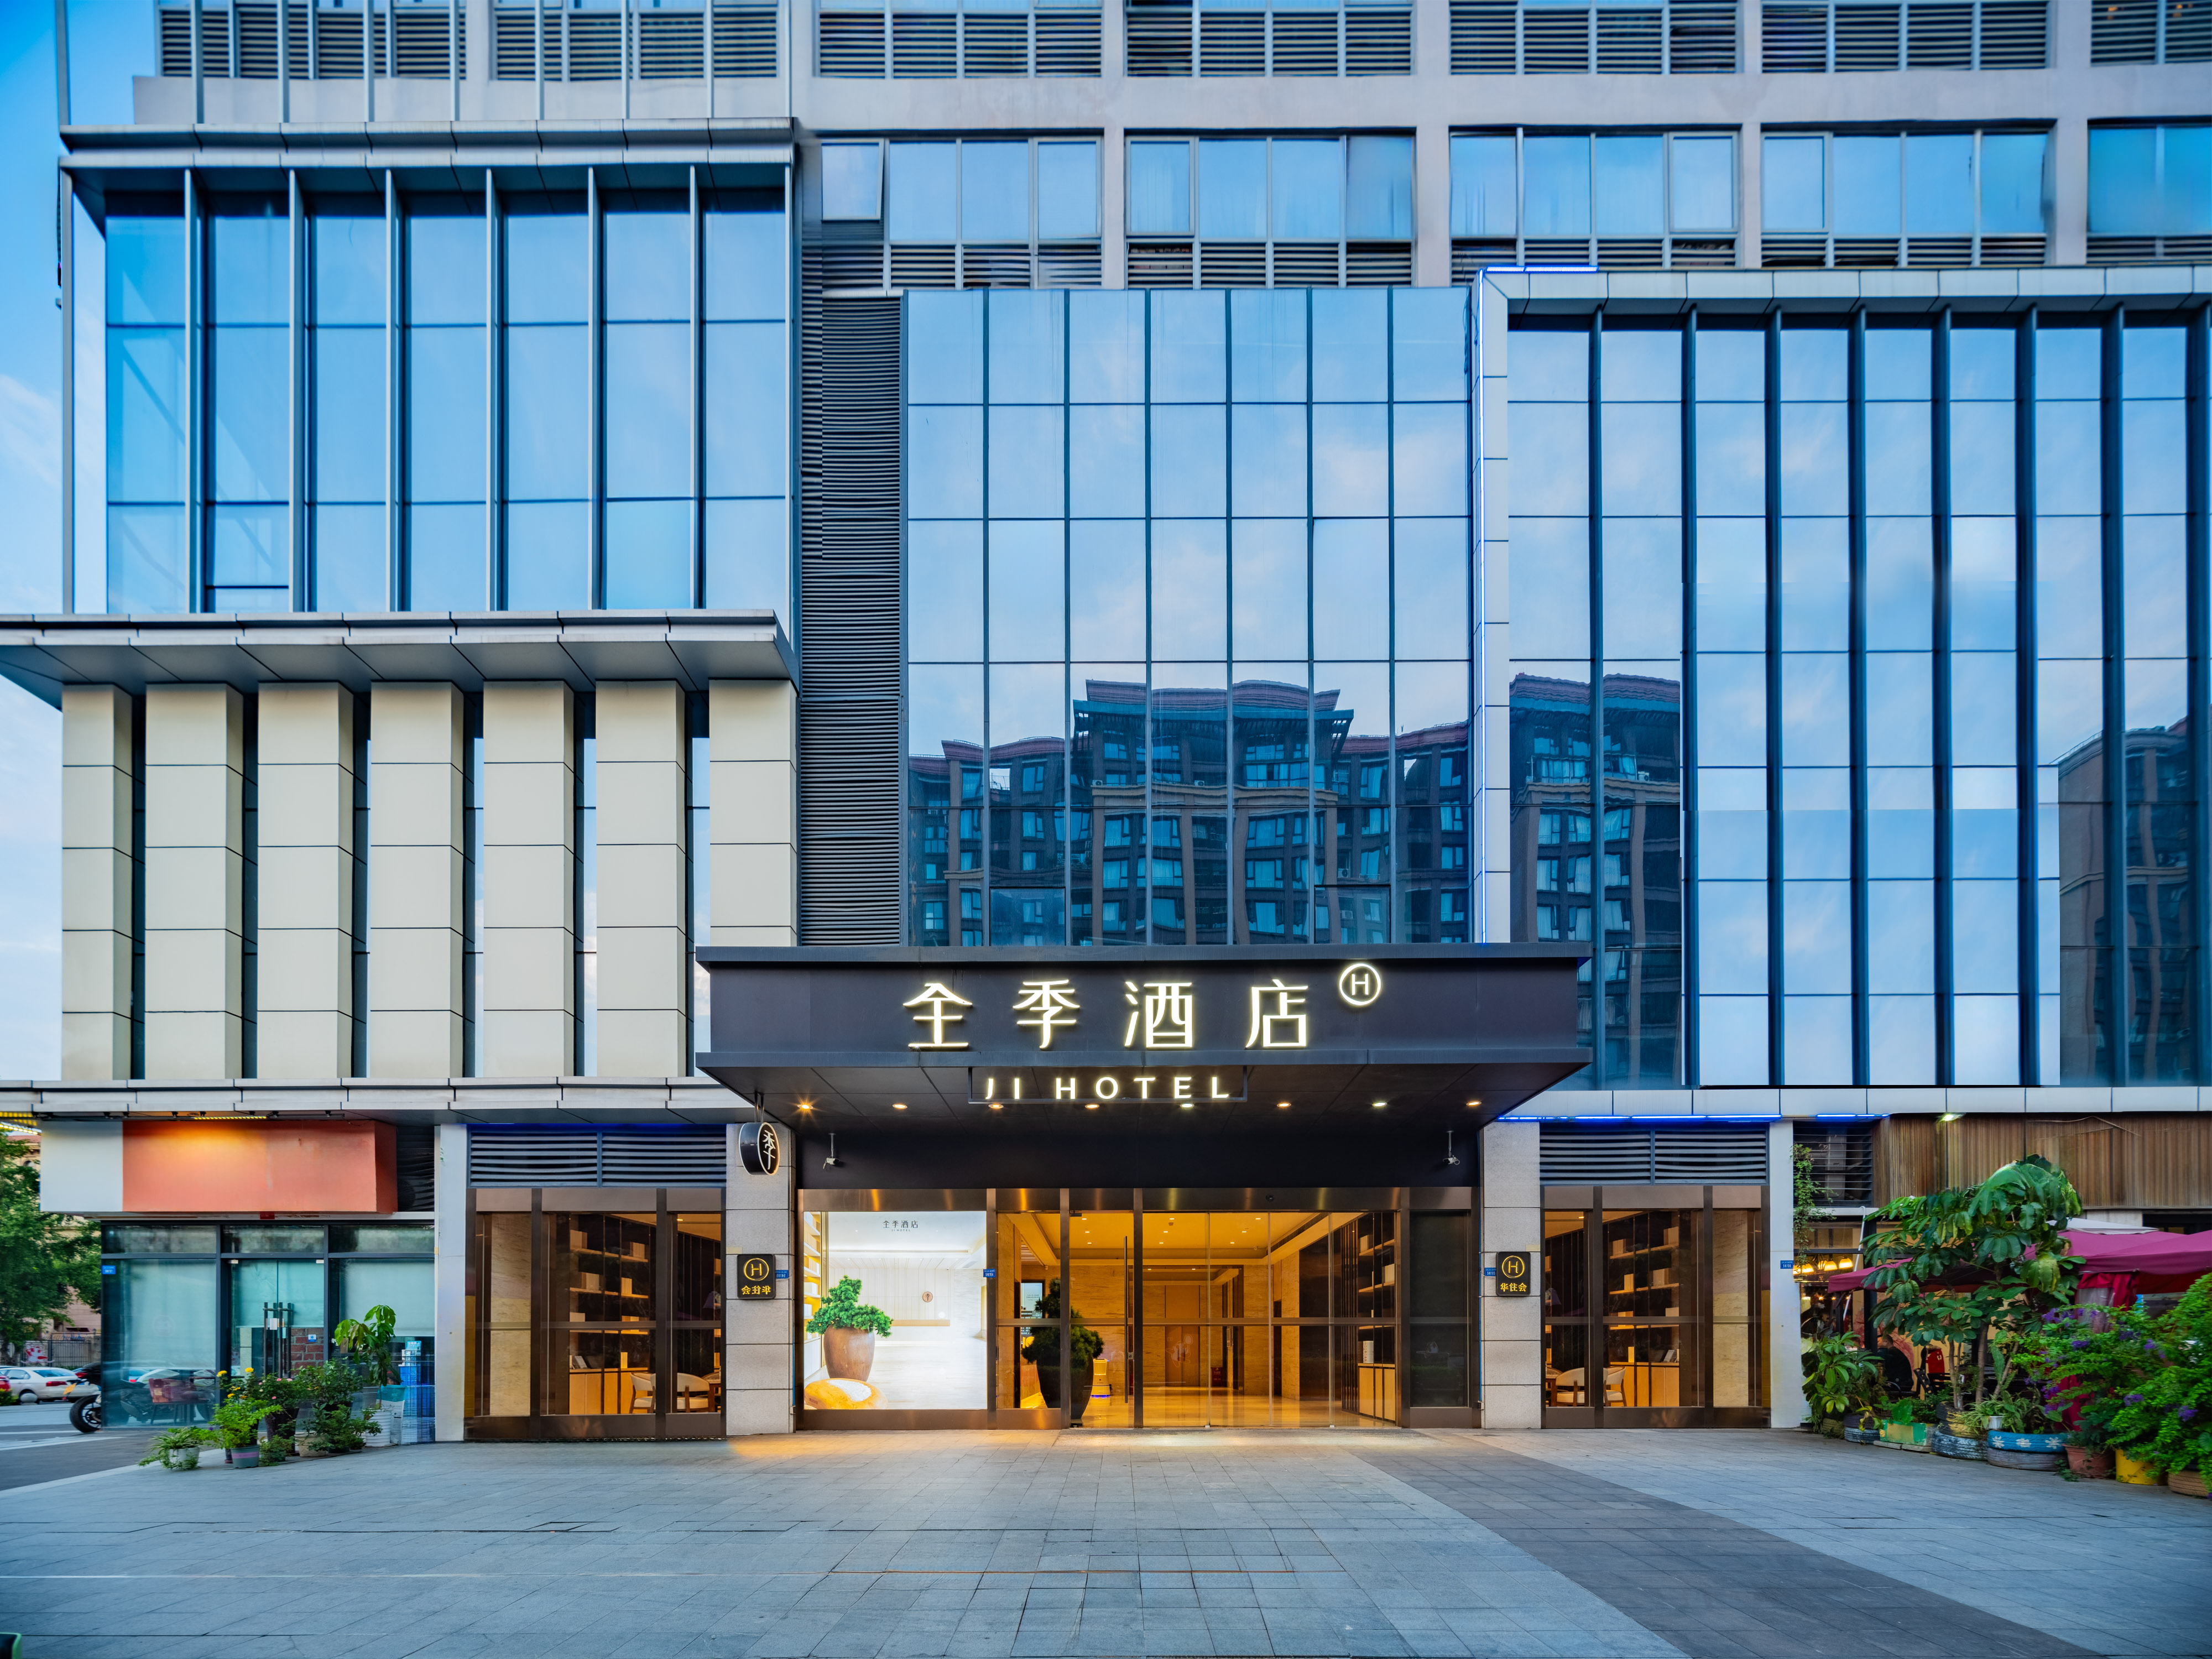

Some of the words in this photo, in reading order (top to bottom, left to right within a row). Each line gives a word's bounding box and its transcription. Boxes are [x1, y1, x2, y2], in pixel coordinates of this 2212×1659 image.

[902, 979, 1309, 1048] 全季酒店
[985, 1077, 1020, 1100] JI
[1055, 1076, 1230, 1100] HOTEL
[762, 1129, 776, 1170] 季
[882, 1220, 919, 1229] 全季酒店
[1500, 1282, 1527, 1292] 华住会
